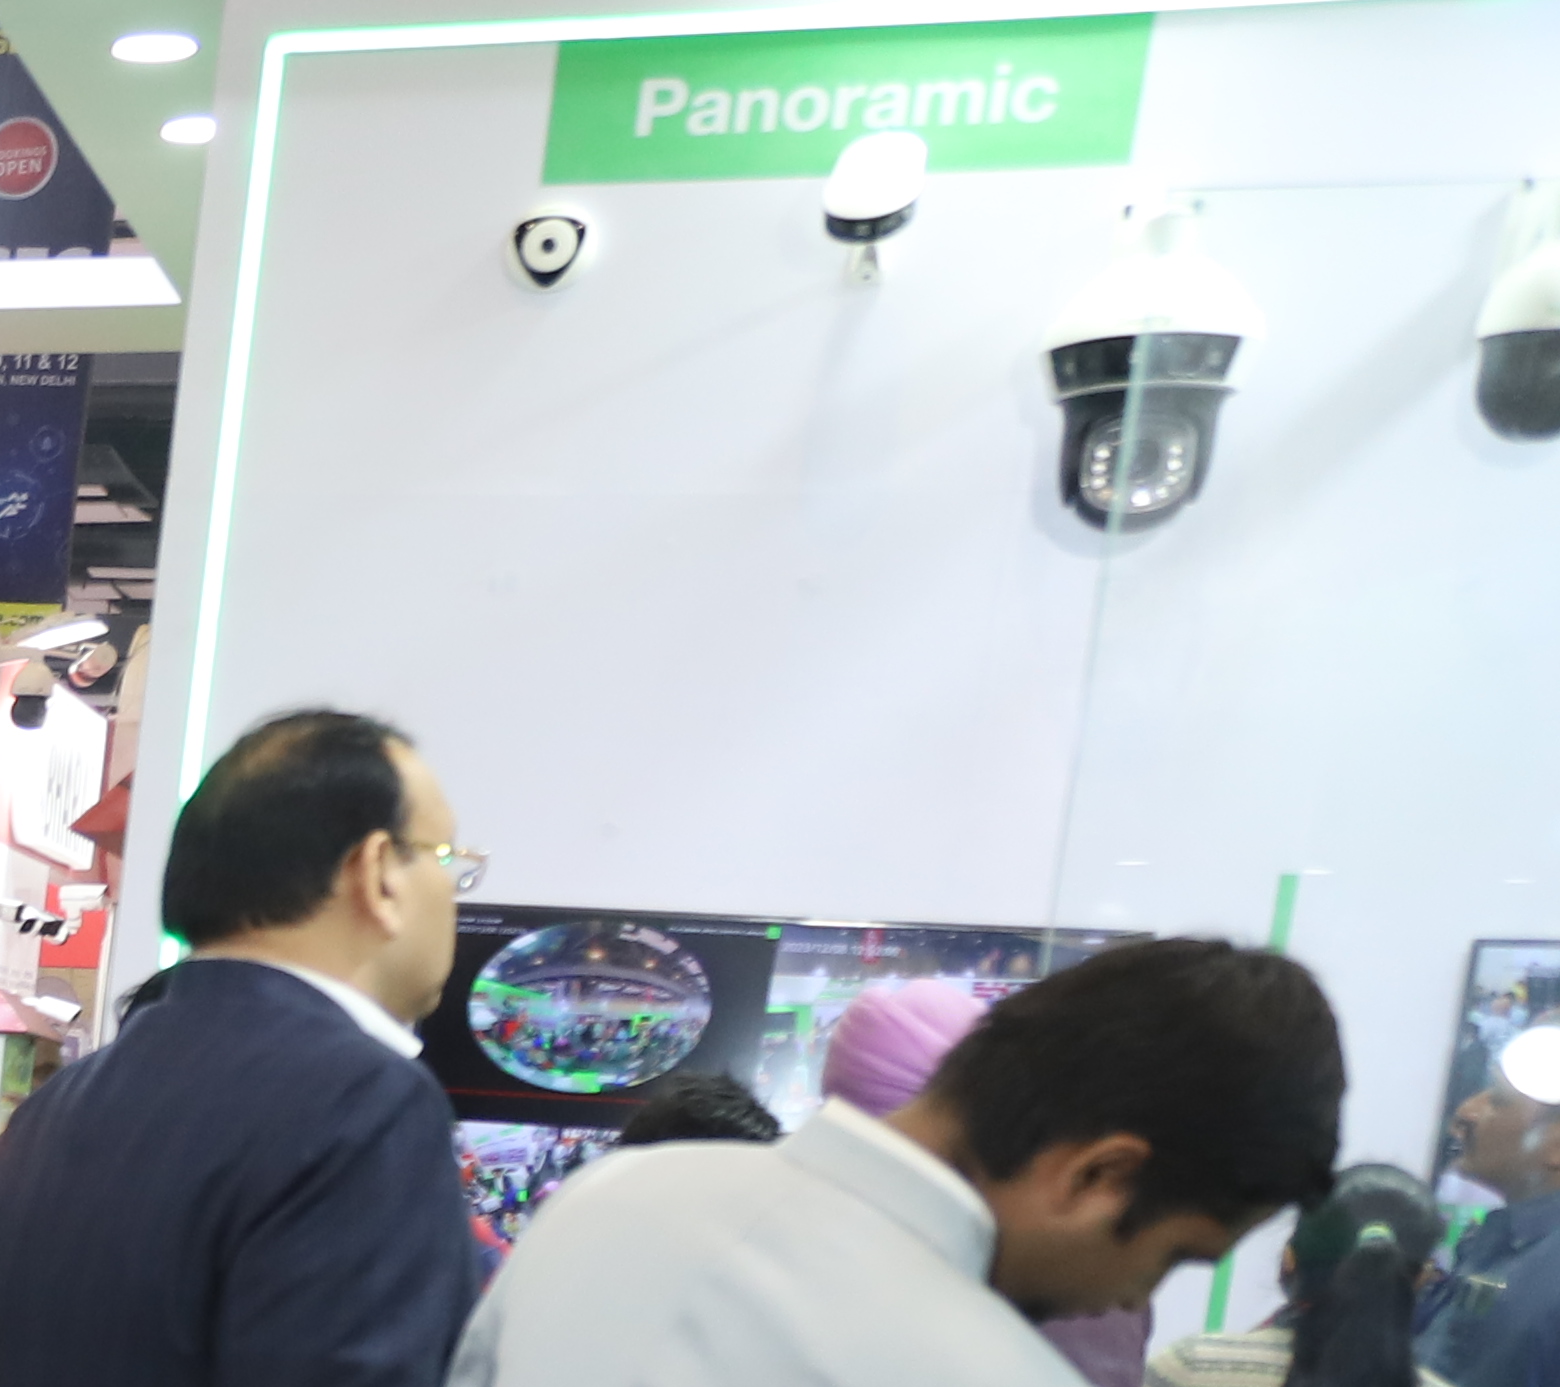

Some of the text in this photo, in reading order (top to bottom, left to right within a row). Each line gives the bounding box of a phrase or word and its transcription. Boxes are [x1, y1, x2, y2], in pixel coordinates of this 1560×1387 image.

[633, 63, 1061, 140] Panoramic
[37, 355, 52, 370] &
[57, 354, 79, 370] 12
[10, 375, 38, 386] NEW
[40, 375, 77, 386] DELHI
